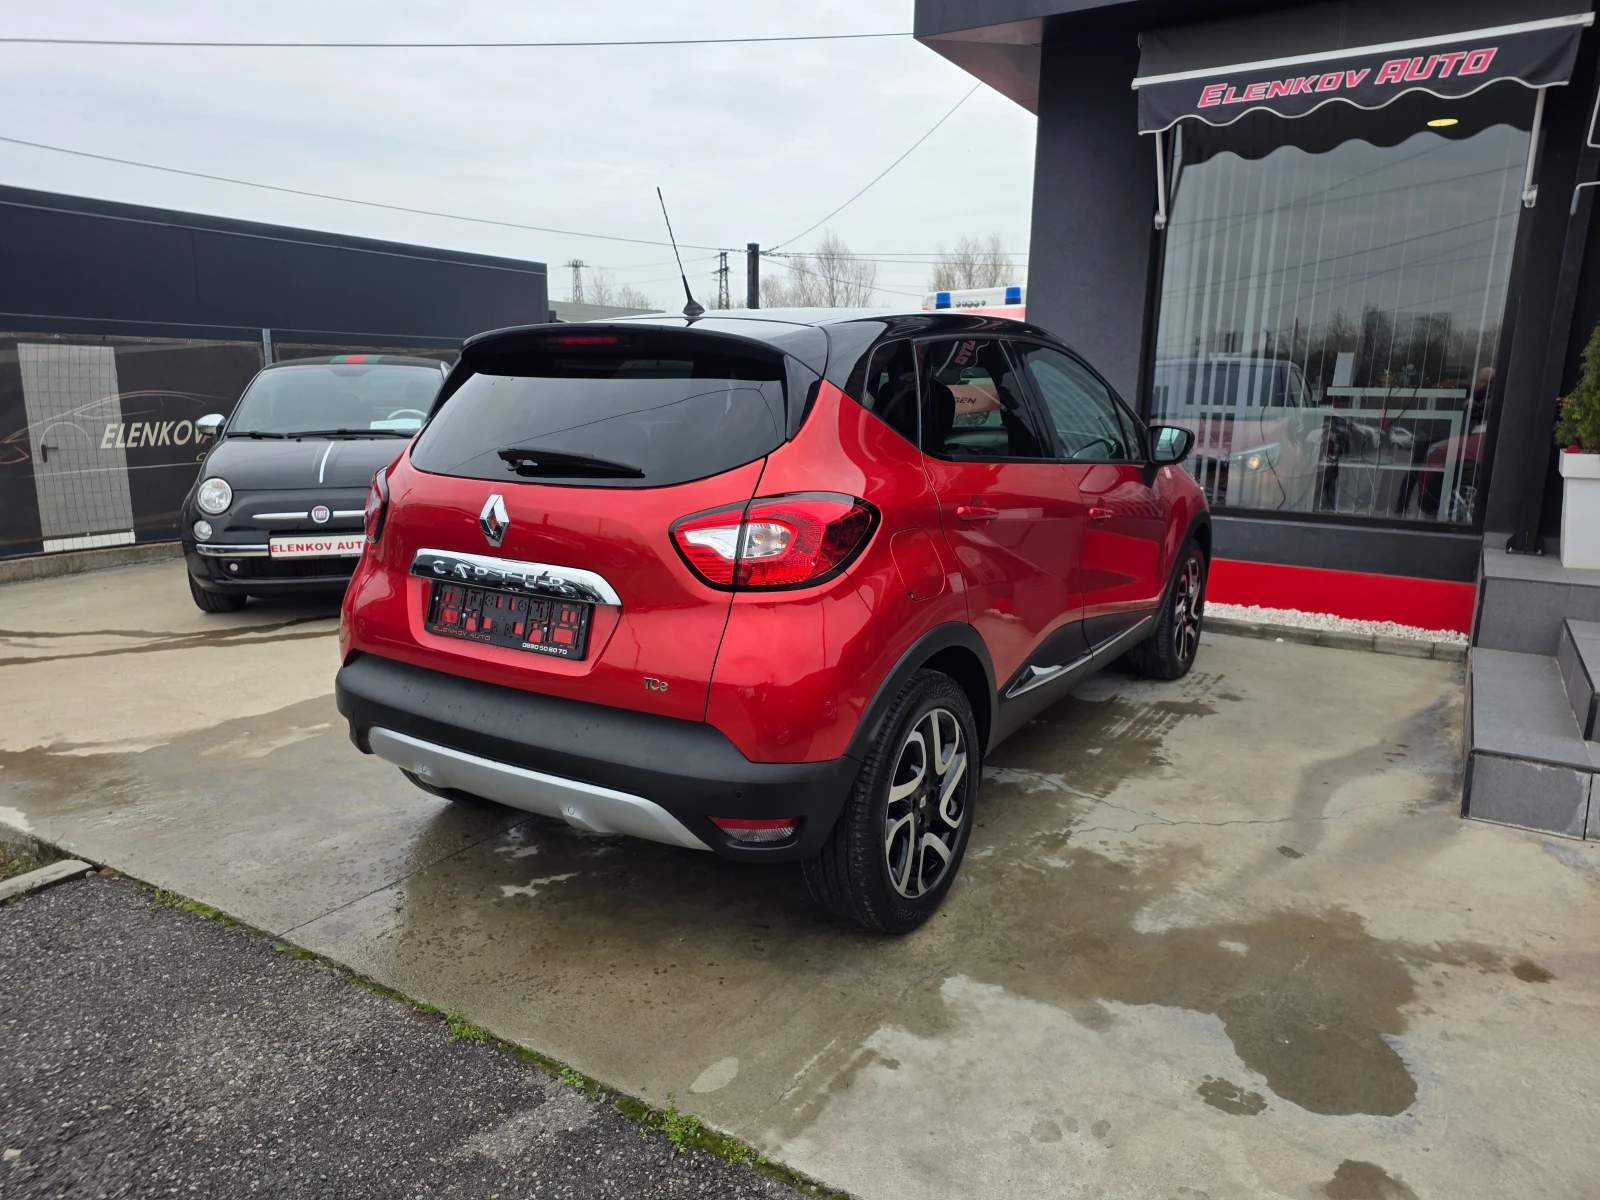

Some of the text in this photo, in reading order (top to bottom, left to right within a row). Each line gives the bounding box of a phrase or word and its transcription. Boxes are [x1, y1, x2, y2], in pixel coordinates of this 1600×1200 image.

[1197, 46, 1498, 108] ELENKOV AUTO
[315, 510, 326, 519] FIAT
[271, 541, 363, 553] ELENKOV AUT
[433, 560, 568, 594] CAPTUR
[433, 625, 491, 641] ELENKOV AUTO
[643, 676, 668, 692] TCe
